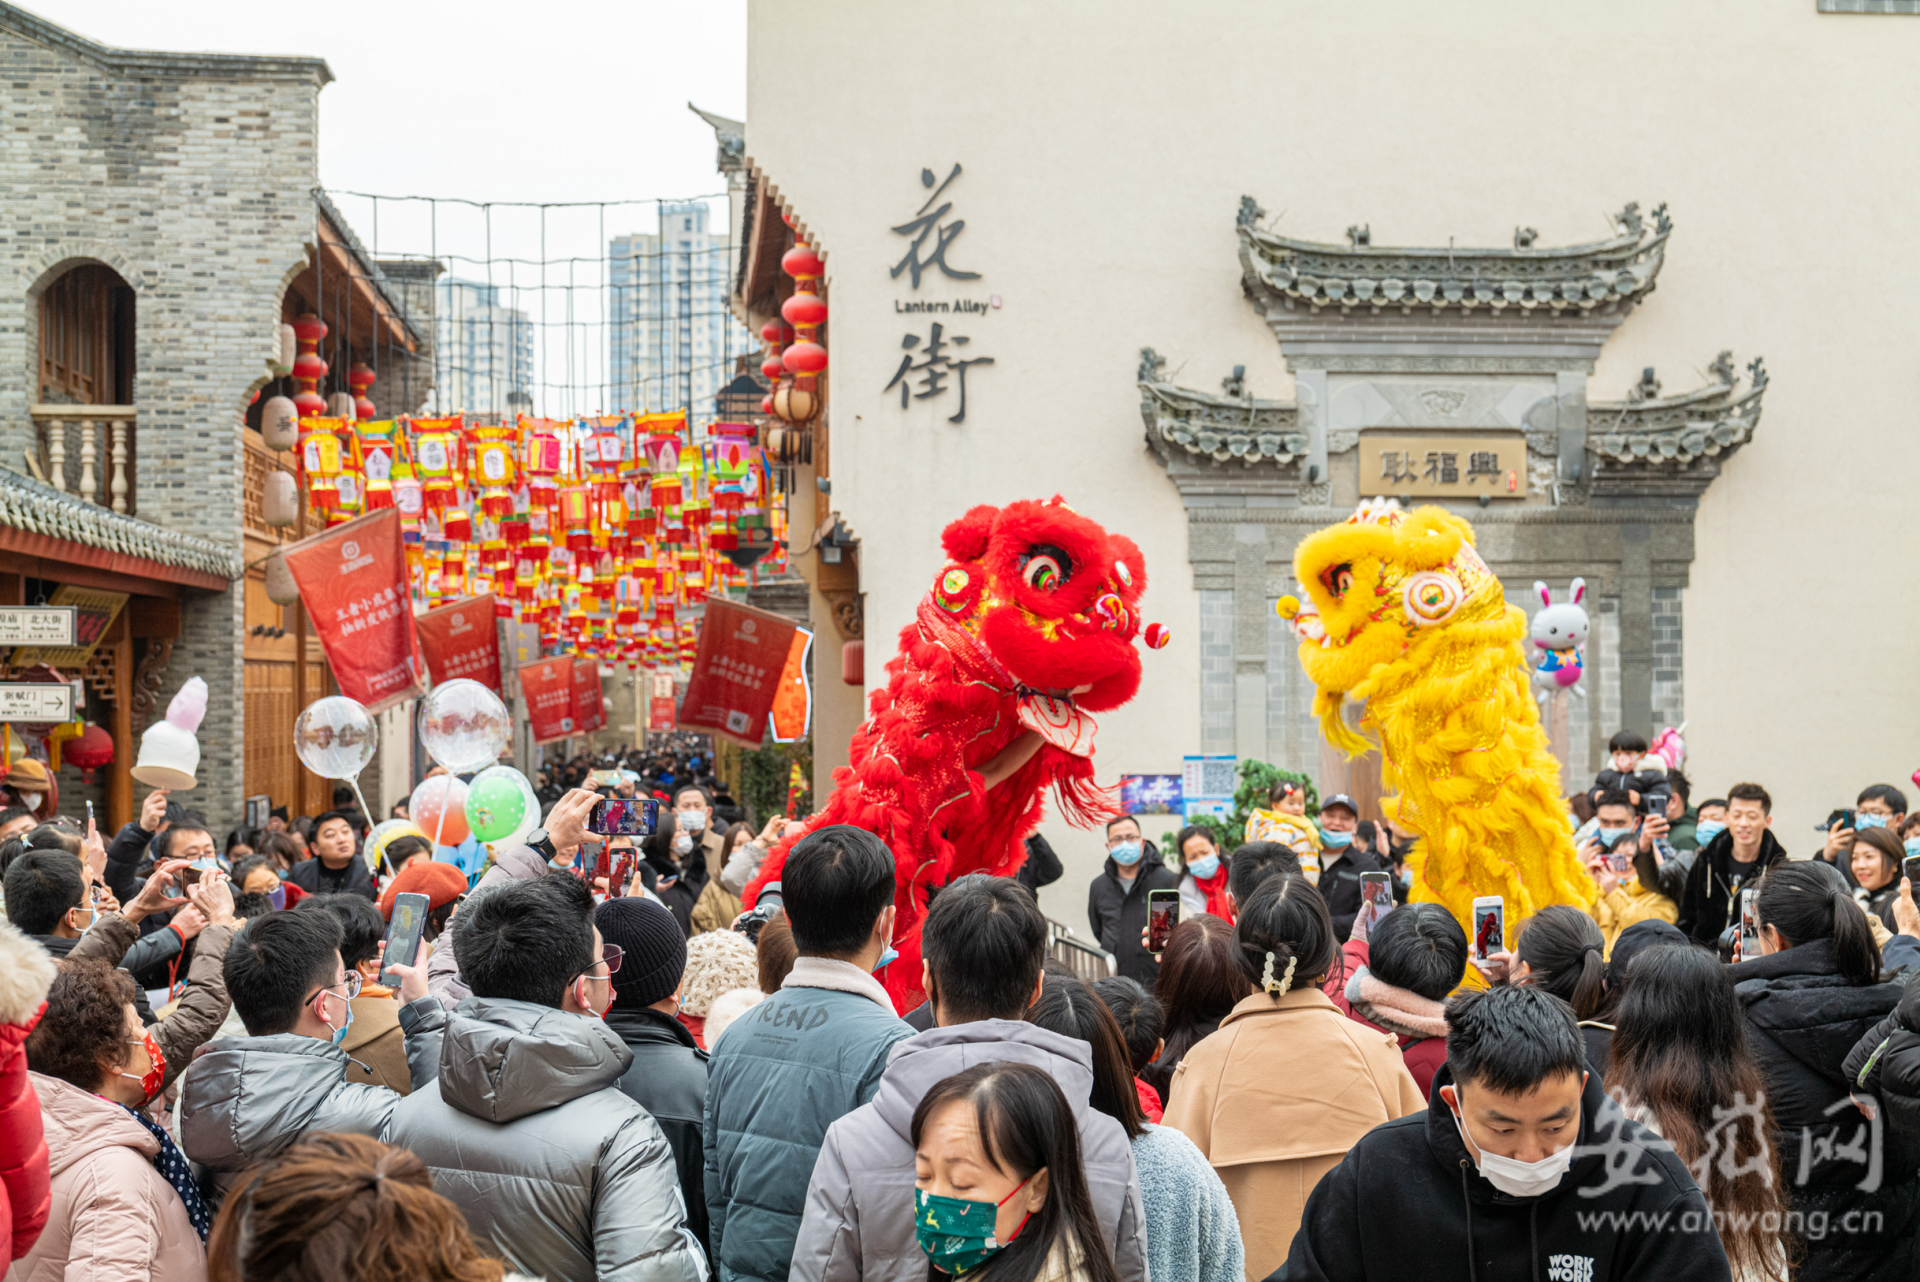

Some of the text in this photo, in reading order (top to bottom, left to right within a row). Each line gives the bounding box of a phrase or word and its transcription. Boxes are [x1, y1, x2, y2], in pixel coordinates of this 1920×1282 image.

[890, 162, 983, 290] 花
[895, 299, 989, 316] Lantern Alley
[883, 322, 995, 424] 街
[745, 1000, 830, 1032] TREND
[1548, 1254, 1595, 1274] WORK
[1548, 1267, 1594, 1282] WORK
